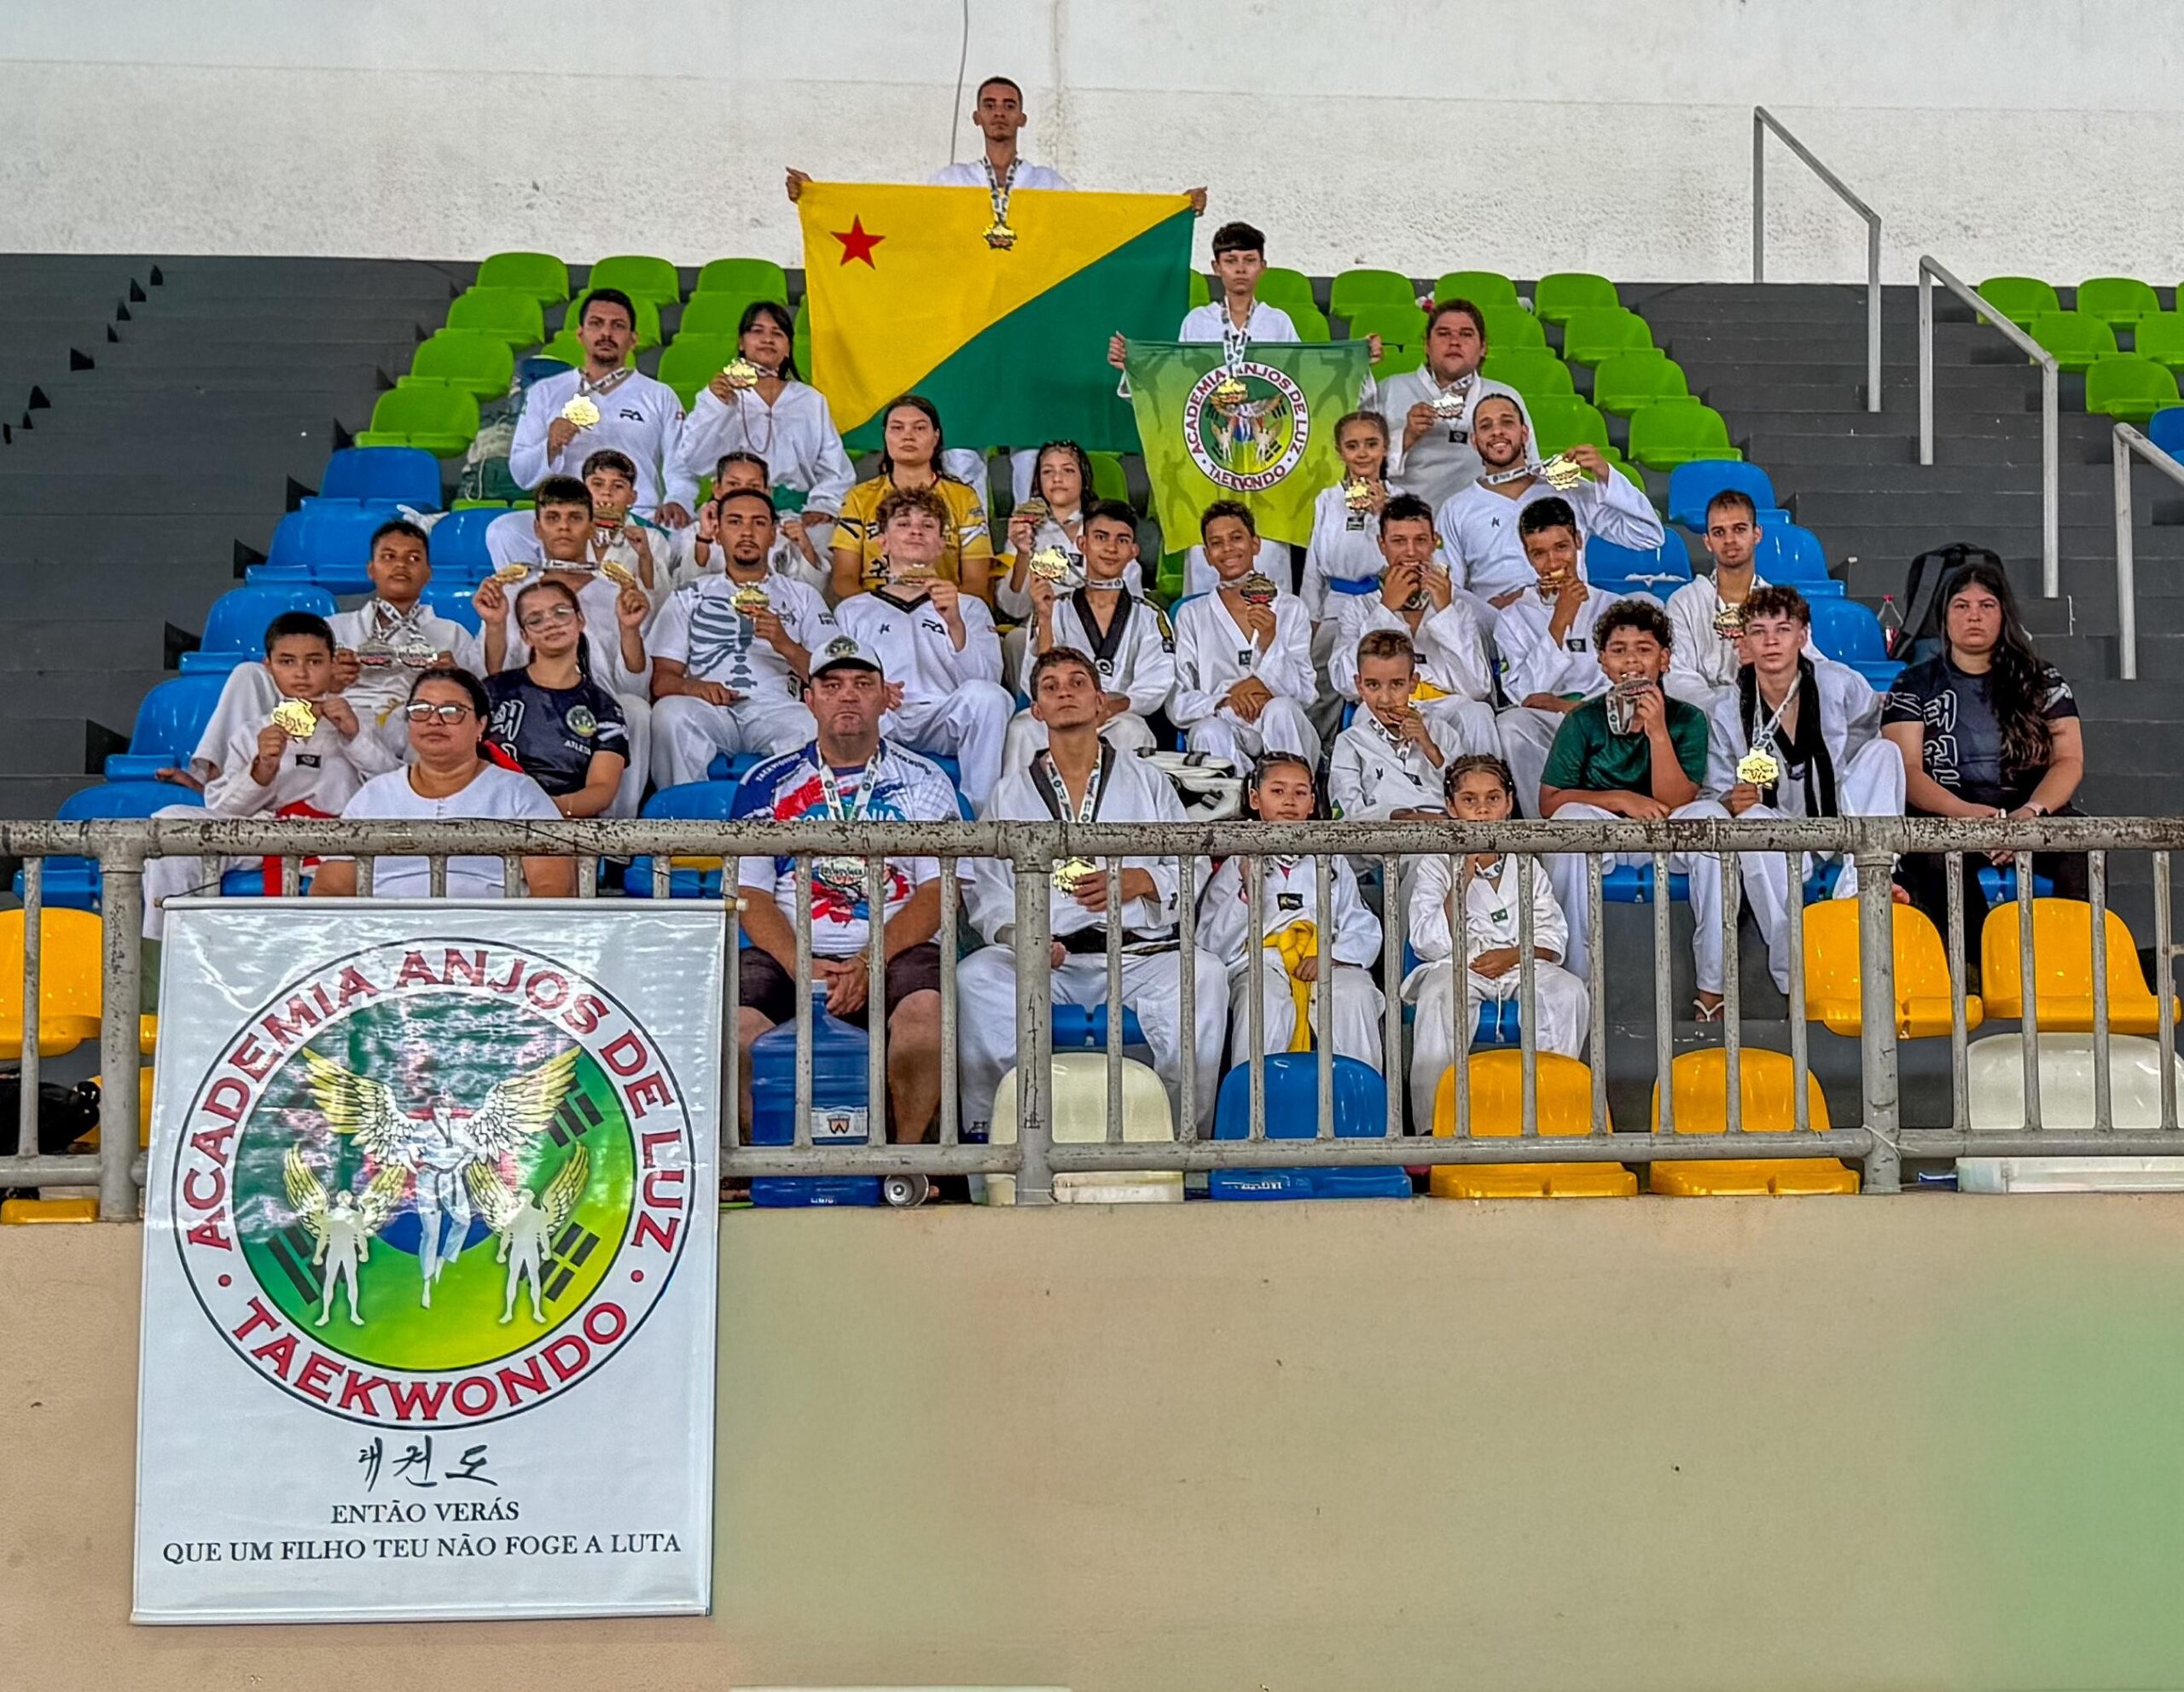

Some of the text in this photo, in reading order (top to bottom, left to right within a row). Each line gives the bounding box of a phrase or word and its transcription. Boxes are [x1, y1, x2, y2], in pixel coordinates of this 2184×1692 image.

[1186, 369, 1226, 454] ACADEMIA
[1289, 389, 1306, 416] DE
[1289, 419, 1307, 455] LUZ
[183, 948, 685, 1253] ACADEMIA ANJOS DE LUZ
[231, 1296, 628, 1422] TAEKWONDO
[330, 1497, 520, 1524] ENTÃO VERÁS
[163, 1533, 682, 1565] QUE UM FILHO TEU NÃO FOGE A LUTA
